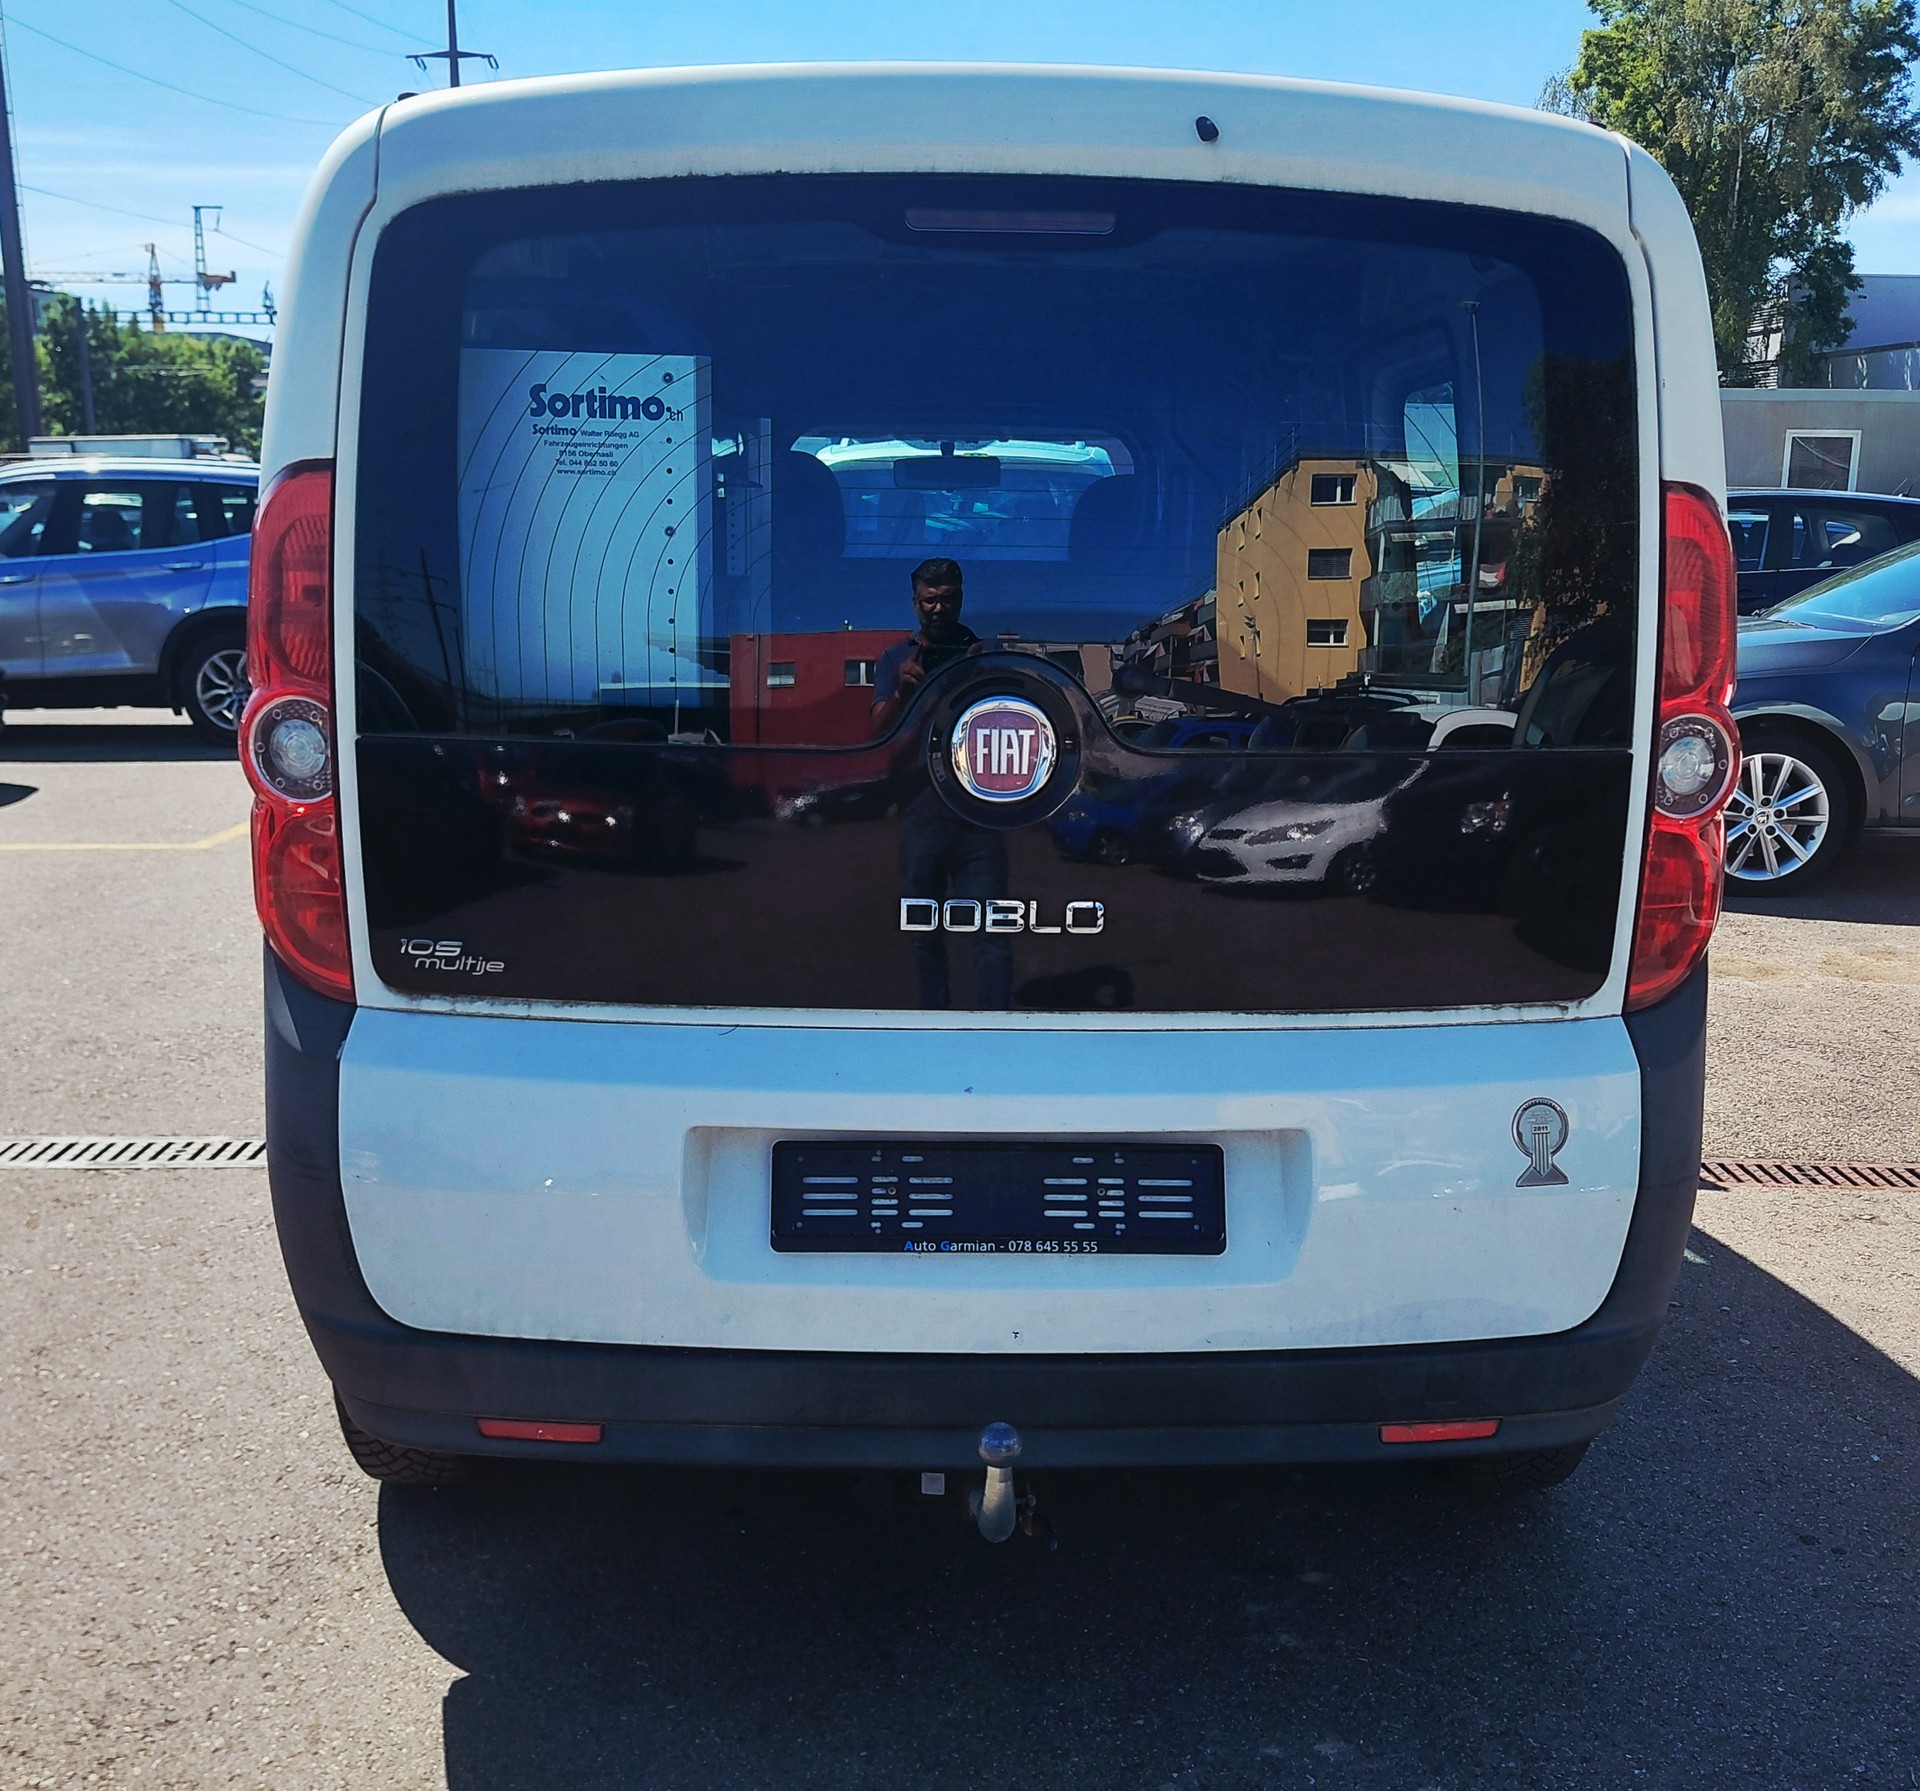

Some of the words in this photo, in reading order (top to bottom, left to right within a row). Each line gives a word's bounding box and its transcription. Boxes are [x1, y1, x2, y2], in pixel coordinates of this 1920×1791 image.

[532, 423, 577, 436] Sortimo
[580, 429, 603, 437] Walter
[559, 449, 576, 457] 8156
[578, 450, 614, 458] Obehasli
[556, 468, 617, 476] www.sortimo.ch
[975, 728, 1035, 775] FIAT
[900, 898, 1105, 935] DOBLO
[400, 938, 463, 957] 105
[414, 955, 505, 975] multije
[904, 1240, 937, 1252] Auto
[940, 1239, 996, 1252] Garmian
[1008, 1240, 1032, 1252] 078
[1035, 1240, 1059, 1252] 645
[1063, 1241, 1078, 1252] 55
[1082, 1241, 1098, 1253] 55
